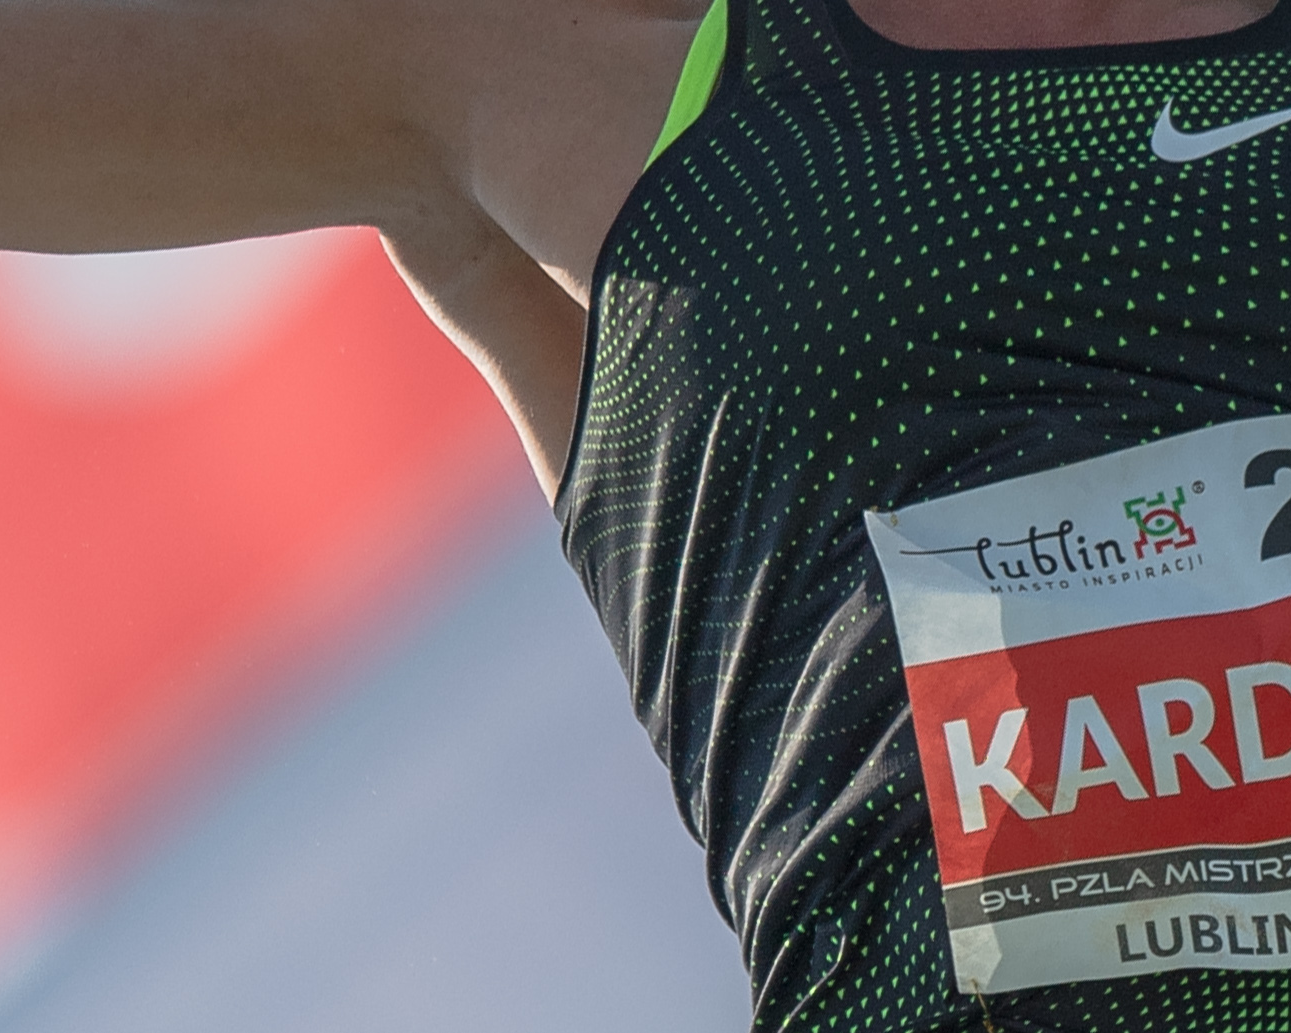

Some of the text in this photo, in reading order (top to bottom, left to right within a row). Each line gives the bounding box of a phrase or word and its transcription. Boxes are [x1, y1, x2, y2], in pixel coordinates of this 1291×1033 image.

[899, 519, 1126, 580] lublin
[990, 553, 1204, 595] MIASTO INSPIRACJI
[979, 884, 1041, 914] 94.
[1050, 868, 1155, 900] PZLA
